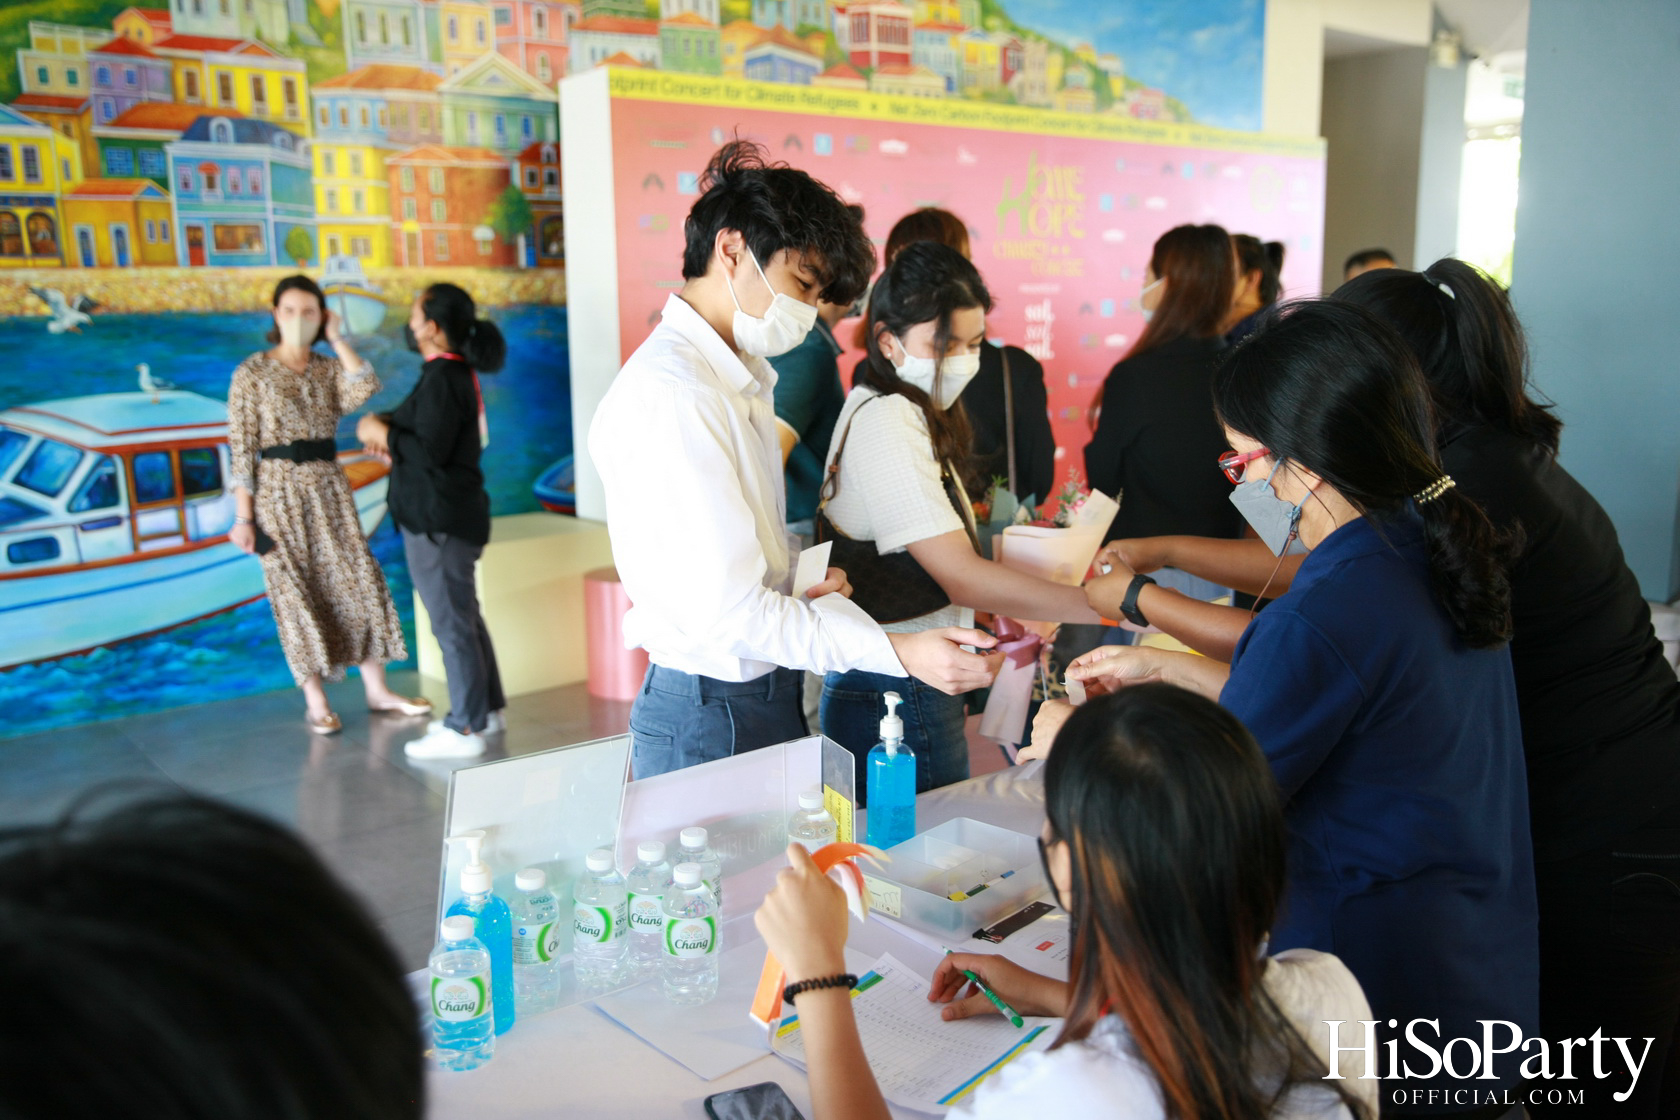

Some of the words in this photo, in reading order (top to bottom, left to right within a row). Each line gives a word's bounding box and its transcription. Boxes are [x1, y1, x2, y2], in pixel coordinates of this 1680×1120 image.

[660, 76, 721, 98] Concert
[724, 83, 742, 100] for
[746, 84, 796, 103] Climate
[800, 91, 860, 113] Refugees
[631, 912, 662, 927] Chang
[573, 919, 601, 938] Chang
[674, 938, 709, 950] Chang
[438, 999, 476, 1013] Chang
